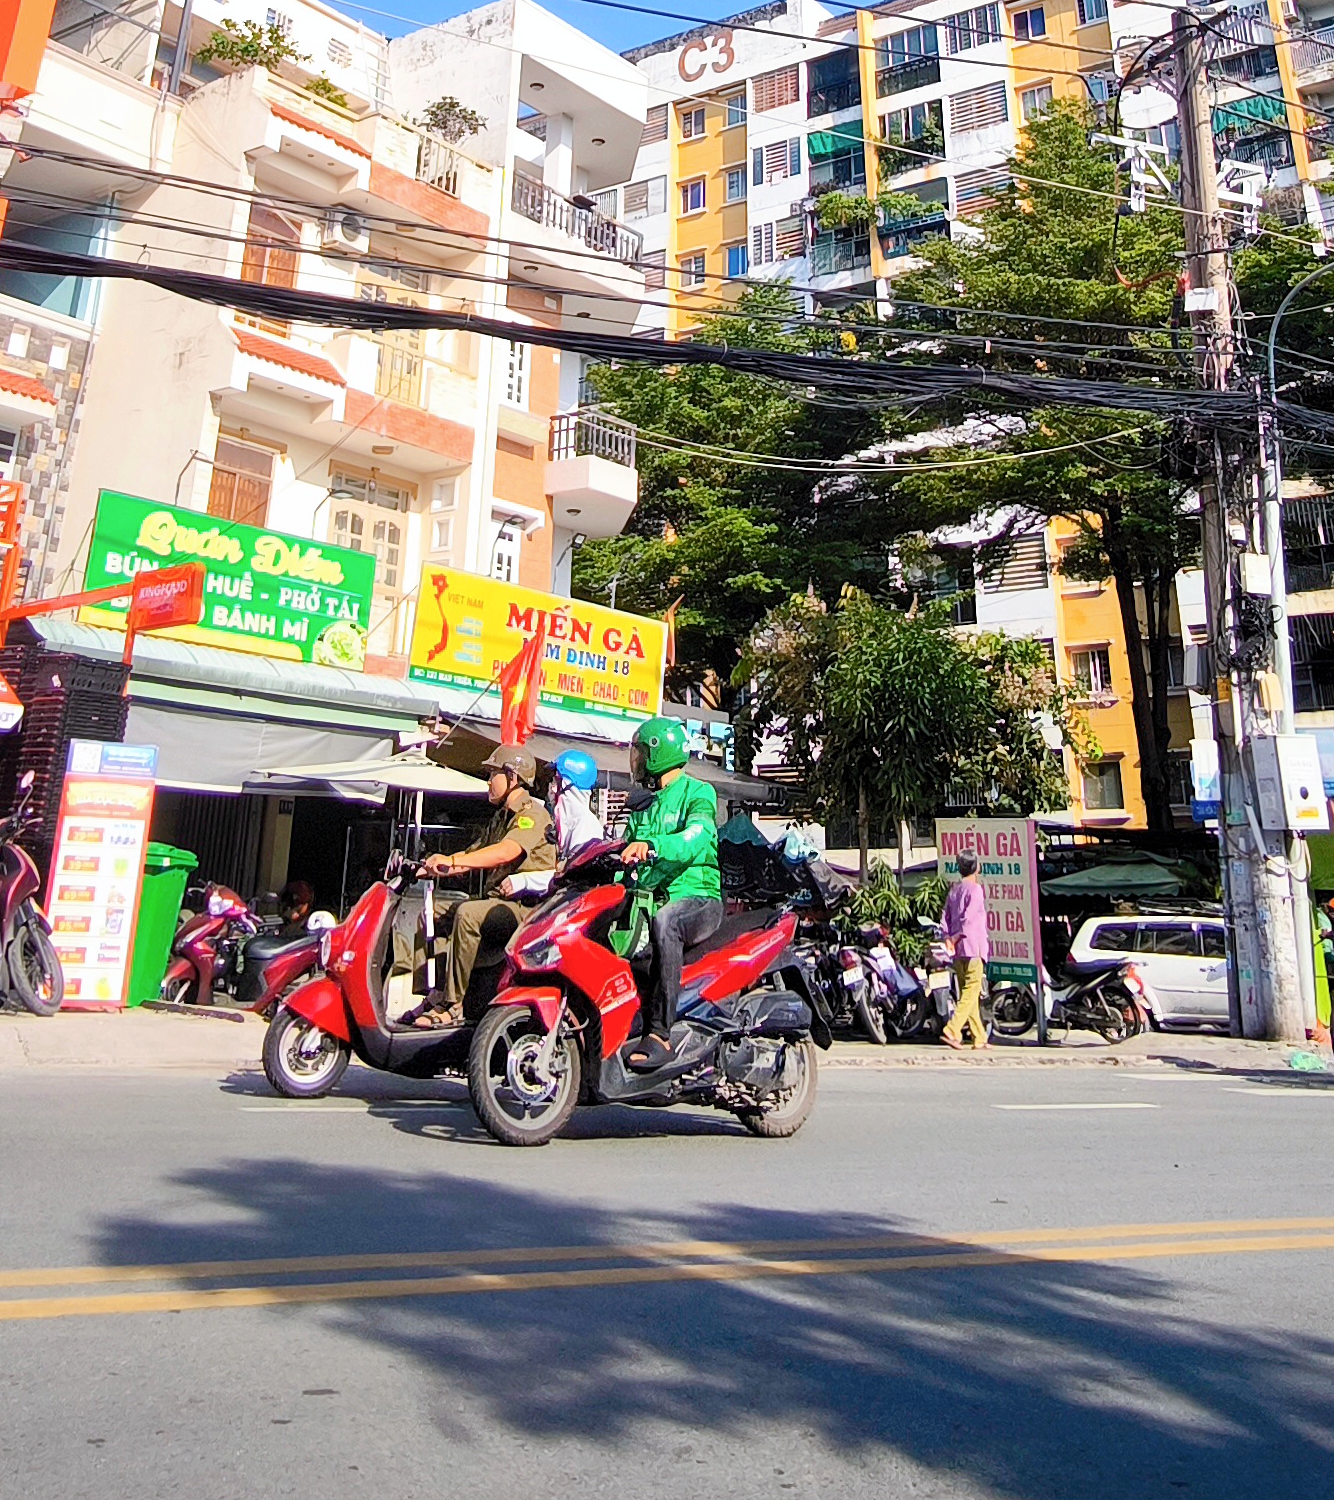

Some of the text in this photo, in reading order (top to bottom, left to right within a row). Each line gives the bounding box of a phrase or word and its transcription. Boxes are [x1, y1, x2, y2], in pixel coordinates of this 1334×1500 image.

[678, 30, 735, 82] C3
[136, 511, 244, 565] Quán
[206, 571, 255, 601] HUẾ
[278, 584, 322, 613] PHỞ
[325, 596, 360, 621] TÁI
[212, 604, 311, 642] BÁNH MÌ
[506, 602, 593, 645] MIẾN
[602, 624, 645, 659] GÀ
[566, 647, 608, 671] ĐỊNH
[613, 659, 630, 675] 18
[941, 823, 1023, 857] MIẾN GÀ
[1007, 862, 1021, 875] 18
[1001, 882, 1025, 901] PHAY
[1005, 906, 1026, 933] GÀ
